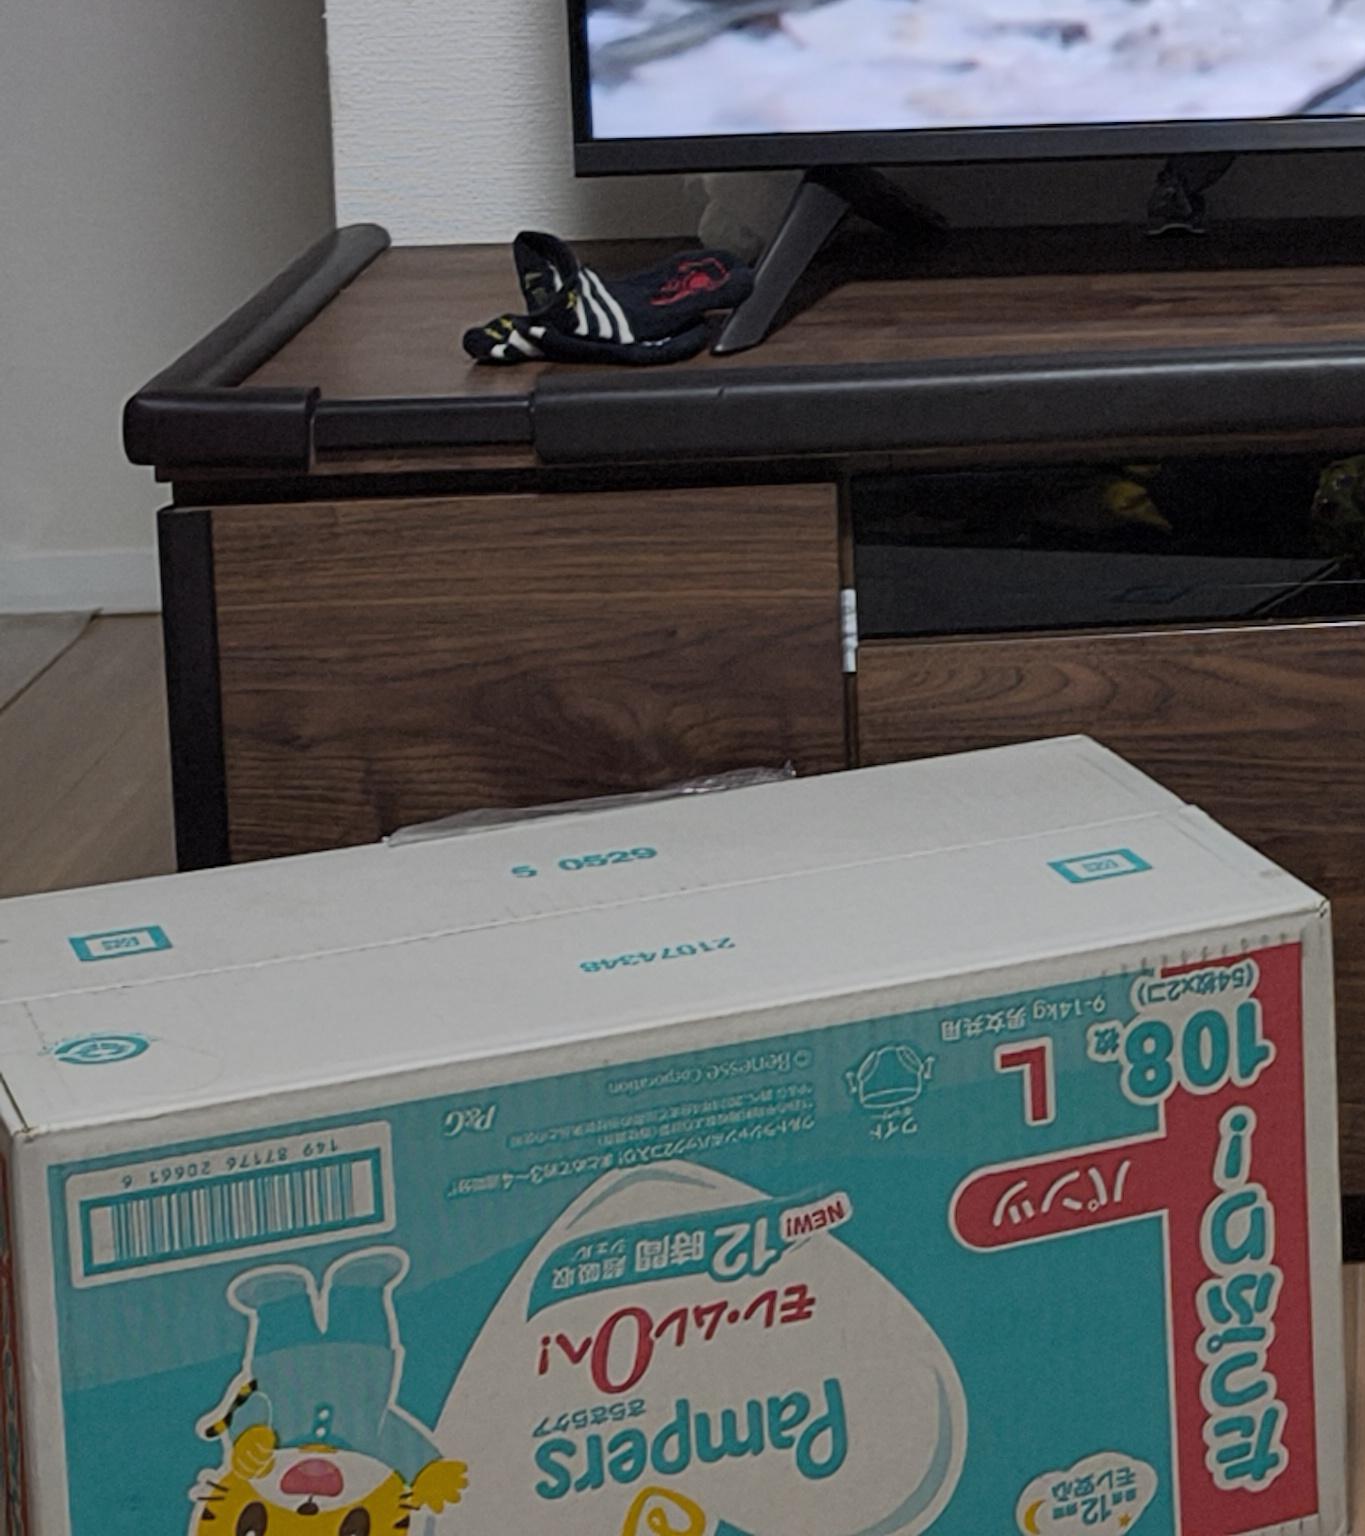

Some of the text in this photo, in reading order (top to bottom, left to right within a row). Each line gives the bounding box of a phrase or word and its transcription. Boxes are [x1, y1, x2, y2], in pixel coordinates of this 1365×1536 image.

[558, 847, 658, 871] 0529
[941, 994, 1106, 1041] 9-14kg 男女共用
[1000, 1045, 1048, 1122] L
[444, 1104, 497, 1136] P&G
[122, 1138, 338, 1189] 149 87176 20661 6
[993, 1160, 1130, 1226] パンツ
[786, 1201, 843, 1237] NEW!
[1207, 1113, 1280, 1481] たっぷり!
[532, 1399, 646, 1438] さらさらケア
[533, 1378, 849, 1499] Pampers
[1051, 1467, 1136, 1499] モレ安心
